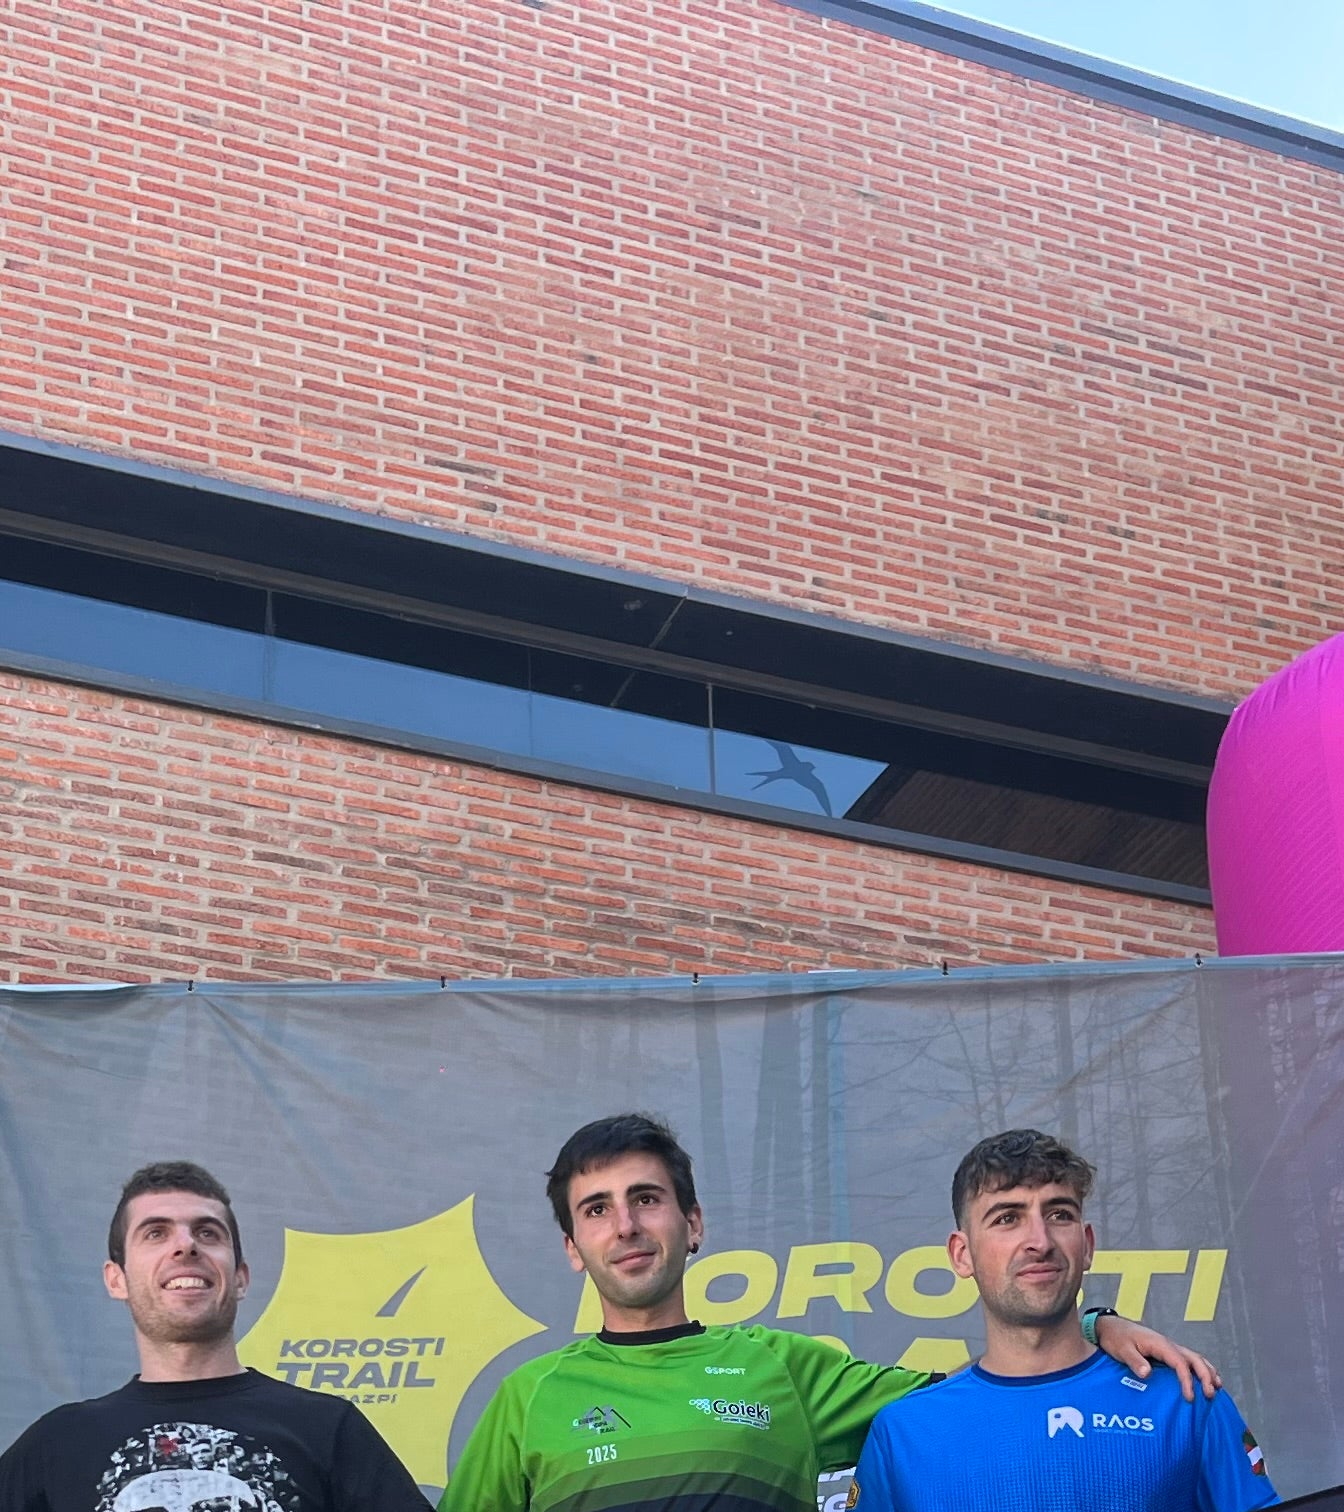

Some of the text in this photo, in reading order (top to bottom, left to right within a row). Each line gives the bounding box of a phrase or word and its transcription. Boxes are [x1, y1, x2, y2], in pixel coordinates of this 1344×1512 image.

[573, 1240, 1229, 1334] OROTI
[280, 1337, 446, 1358] KOROSTI
[276, 1361, 436, 1389] TRAIL
[713, 1399, 770, 1422] Goieki
[1092, 1412, 1155, 1432] RAOS
[587, 1443, 617, 1465] 2025
